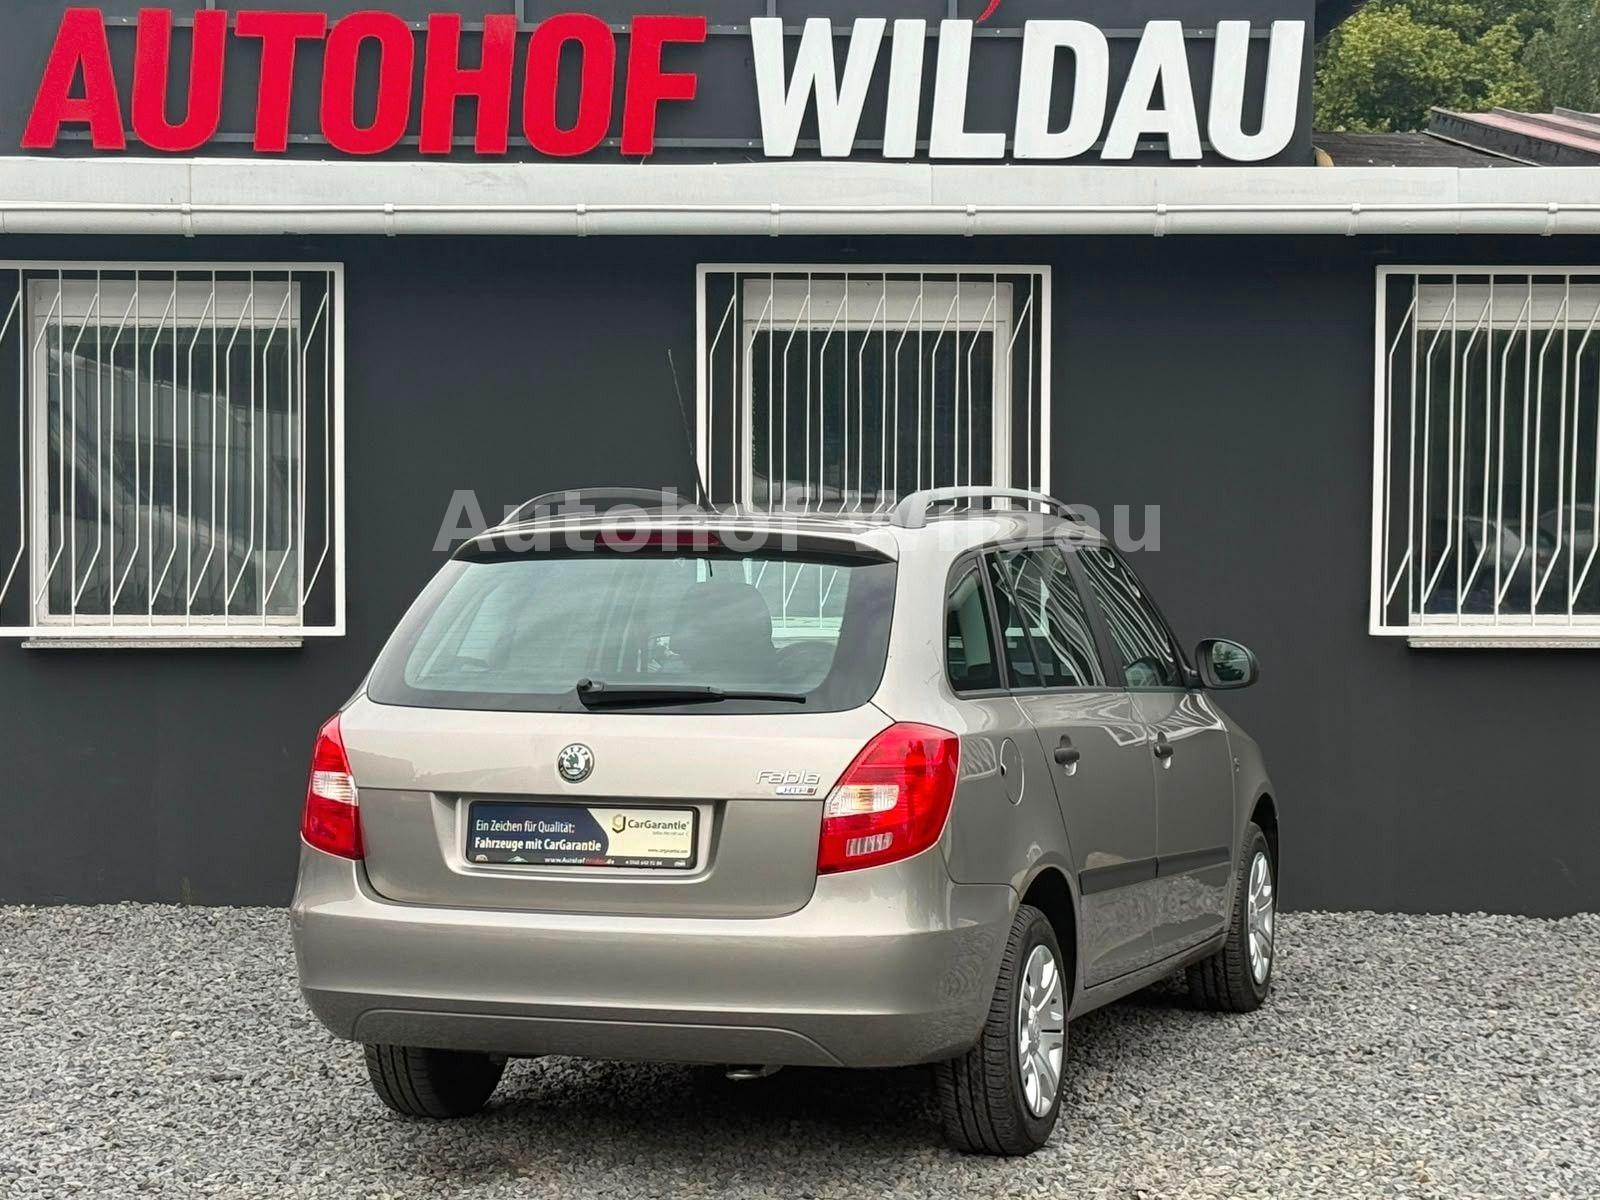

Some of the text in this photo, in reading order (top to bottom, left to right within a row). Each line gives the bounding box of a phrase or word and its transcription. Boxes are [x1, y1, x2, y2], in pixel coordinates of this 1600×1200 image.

[21, 8, 1306, 162] AUTOHOF WILDAU
[755, 769, 821, 785] Fabia
[476, 819, 576, 834] Ein Zeichen für Qualität:
[474, 837, 602, 852] Fahrzeuge mit CarGarantie
